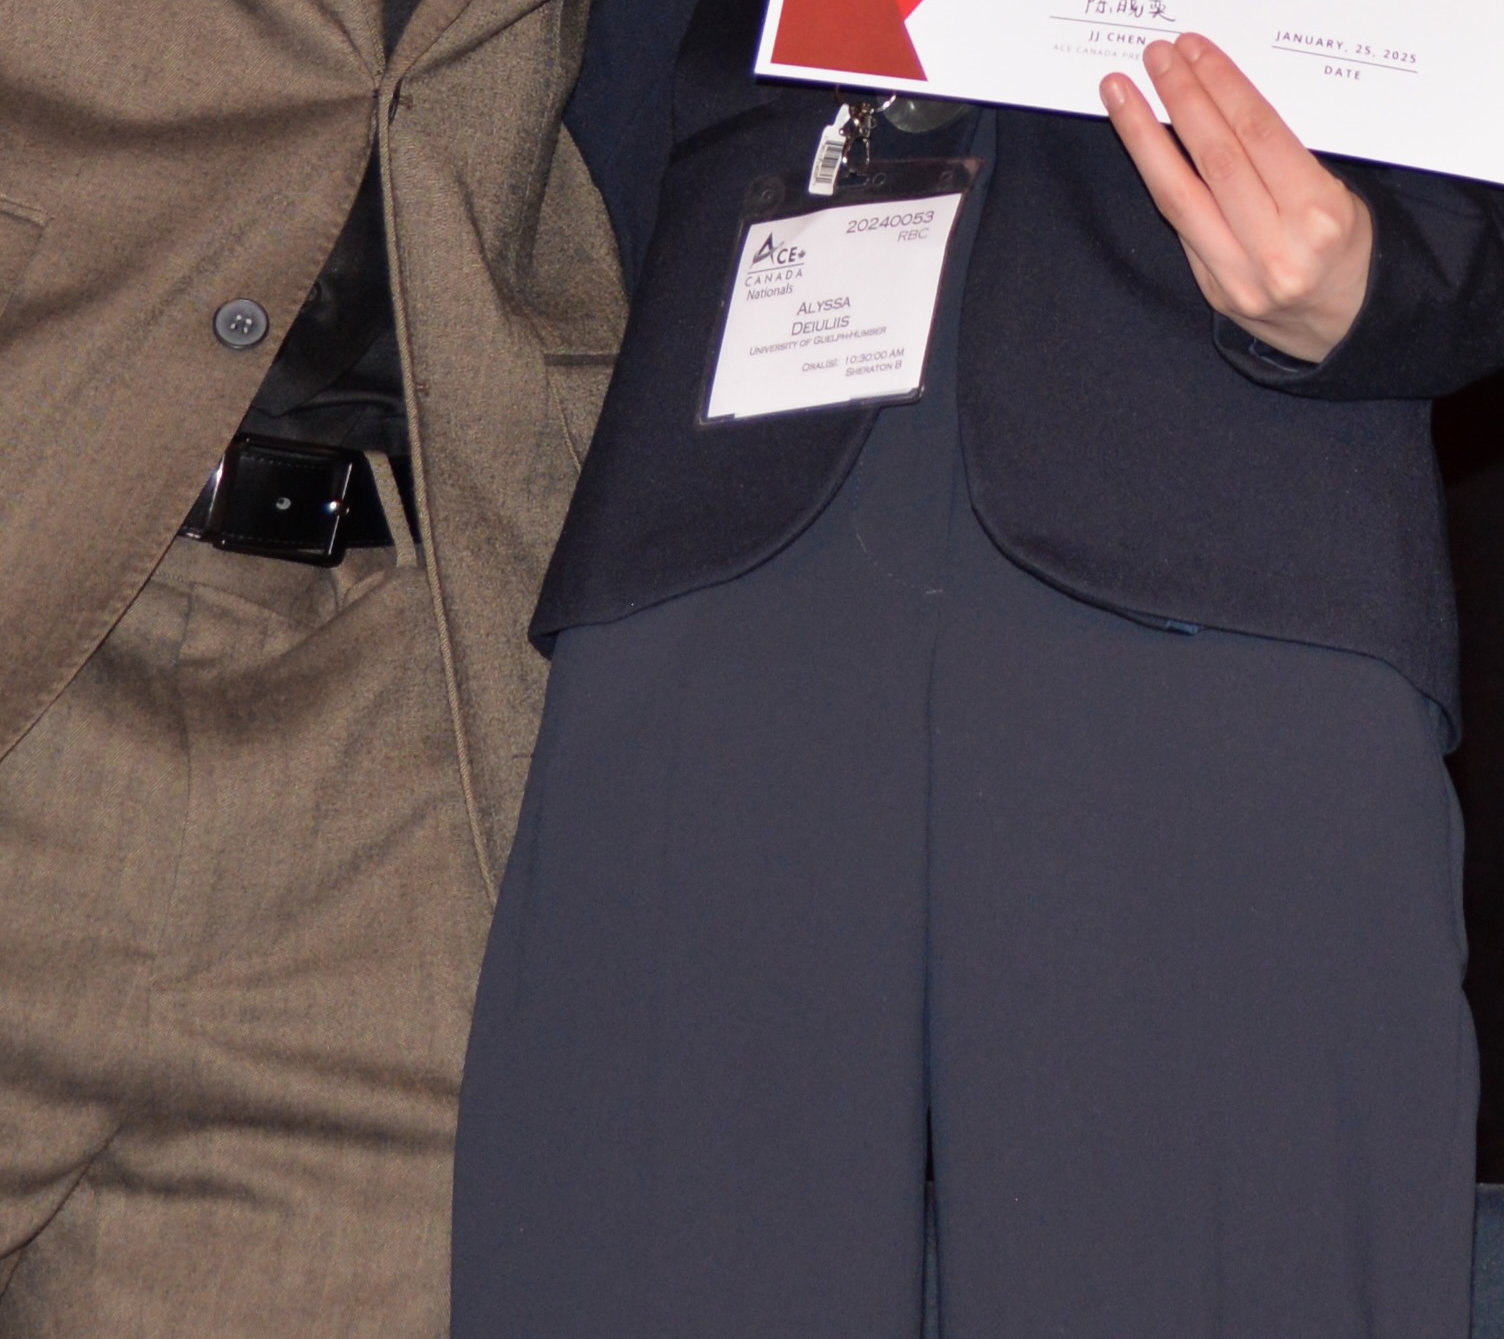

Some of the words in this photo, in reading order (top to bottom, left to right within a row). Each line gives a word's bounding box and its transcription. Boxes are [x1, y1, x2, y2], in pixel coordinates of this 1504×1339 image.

[1089, 31, 1100, 42] JJ
[1107, 32, 1146, 45] CHEN
[1276, 31, 1348, 53] JANUARY,
[1355, 44, 1376, 58] 25,
[1383, 49, 1417, 64] 2025
[1324, 65, 1361, 80] DATE
[846, 210, 934, 234] 20240053
[897, 228, 929, 242] RBC
[745, 268, 803, 287] CANADA
[746, 283, 794, 301] Nationals
[888, 348, 905, 359] AM
